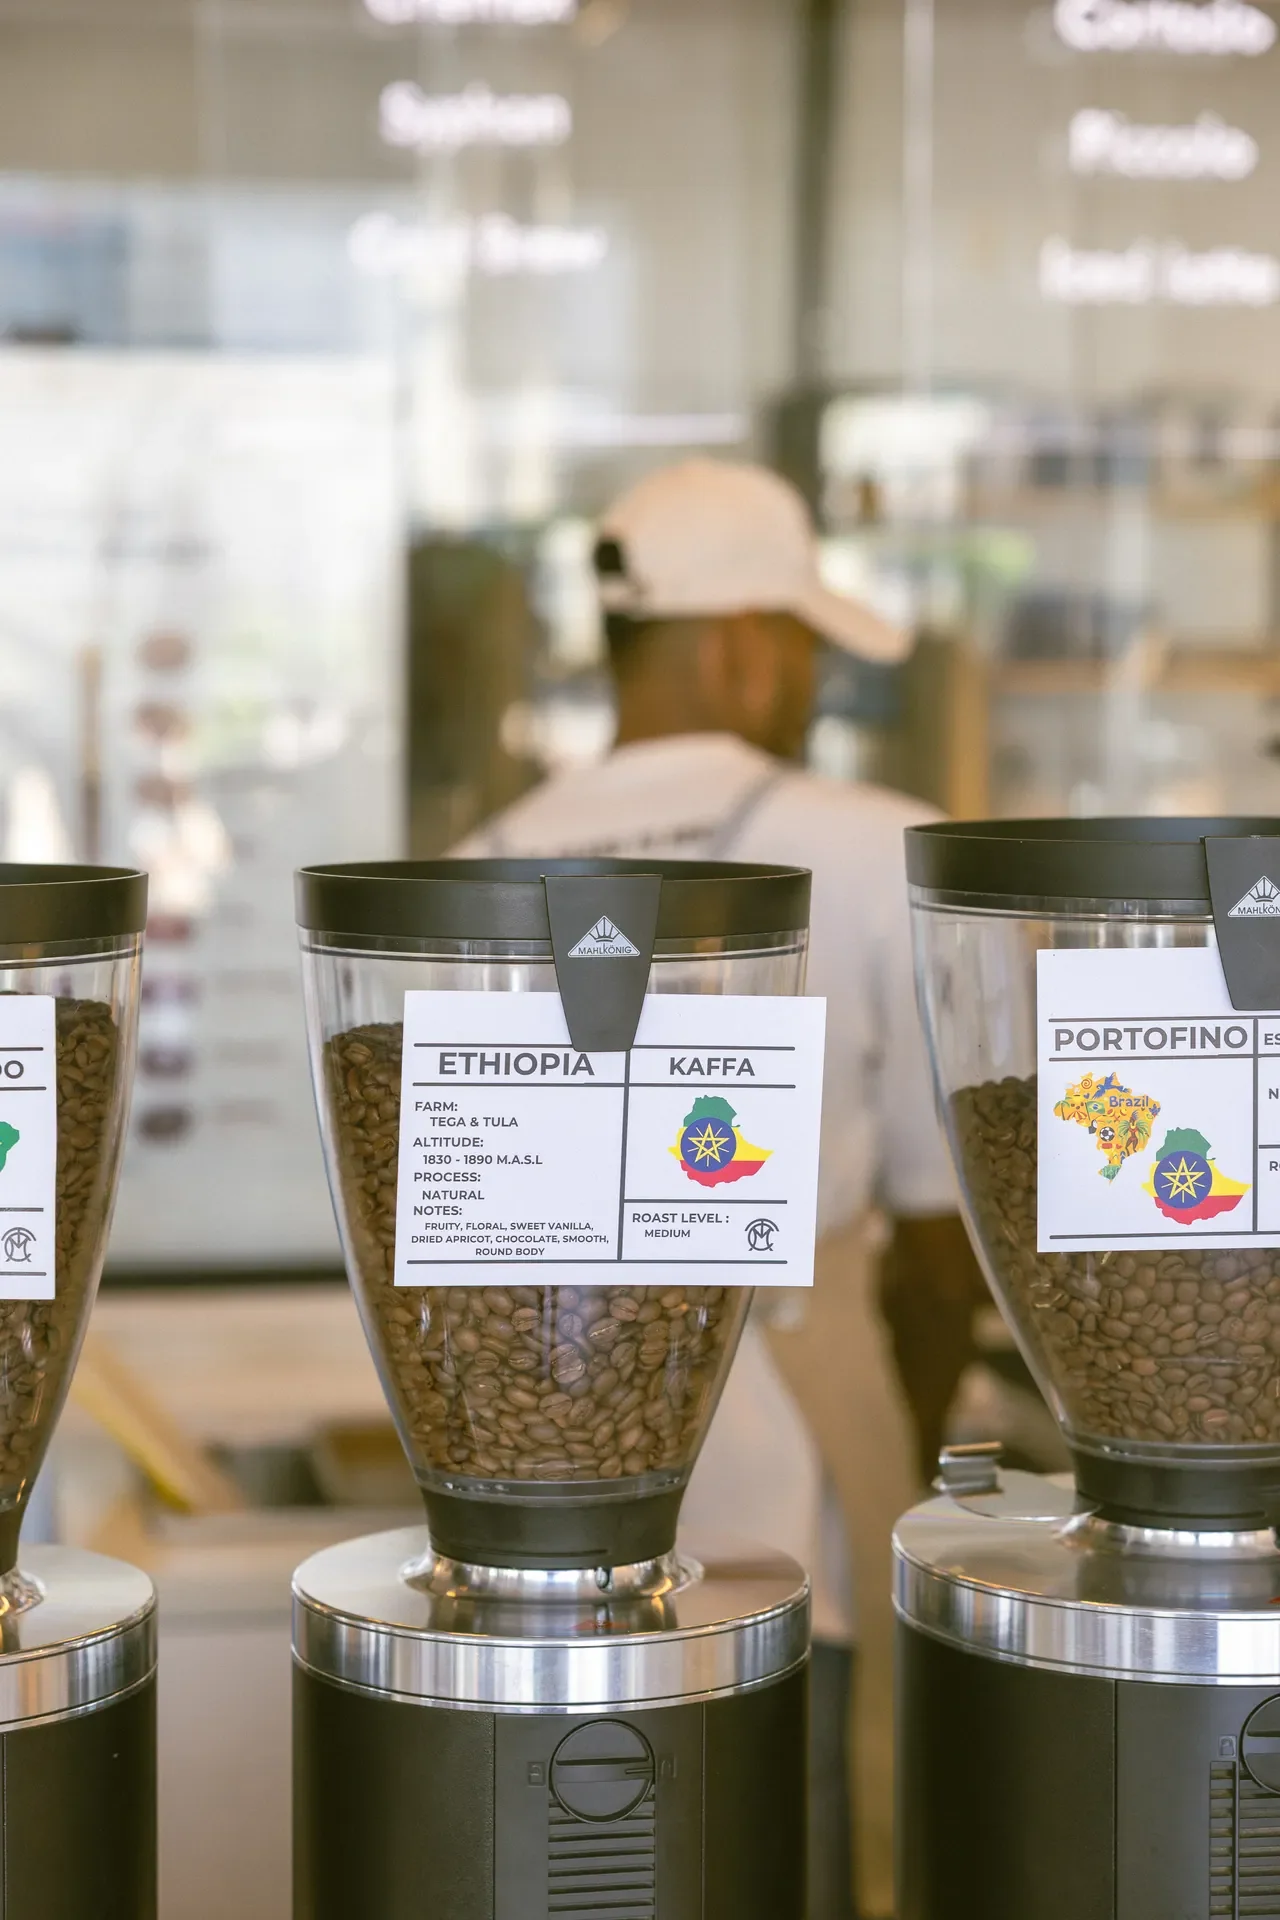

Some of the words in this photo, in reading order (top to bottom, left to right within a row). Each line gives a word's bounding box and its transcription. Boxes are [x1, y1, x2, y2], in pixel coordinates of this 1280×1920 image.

[1055, 1026, 1248, 1052] PORTOFINO
[438, 1052, 595, 1076] ETHIOPIA
[669, 1057, 756, 1077] KAFFA
[415, 1101, 458, 1112] FARM:
[1109, 1095, 1149, 1108] Brazil
[430, 1116, 467, 1127] TEGA
[470, 1116, 479, 1128] &
[483, 1116, 519, 1128] TULA
[412, 1137, 484, 1148] ALTITUDE:
[423, 1154, 452, 1165] 1830
[463, 1154, 493, 1165] 1890
[496, 1154, 543, 1165] M.A.S.L
[413, 1172, 482, 1182] PROCESS:
[422, 1190, 485, 1201] NATURAL
[413, 1205, 463, 1216] NOTES:
[632, 1212, 678, 1223] ROAST
[682, 1213, 723, 1224] LEVEL
[425, 1222, 463, 1231] FRUITY,
[466, 1222, 508, 1231] FLORAL,
[510, 1222, 546, 1231] SWEET
[548, 1222, 594, 1232] VANILLA,
[644, 1229, 691, 1238] MEDIUM
[411, 1235, 443, 1244] DRIED
[446, 1235, 493, 1244] APRICOT,
[495, 1235, 560, 1244] CHOCOLATE,
[562, 1235, 609, 1244] SMOOTH,
[475, 1247, 513, 1256] ROUND
[516, 1247, 545, 1256] BODY
